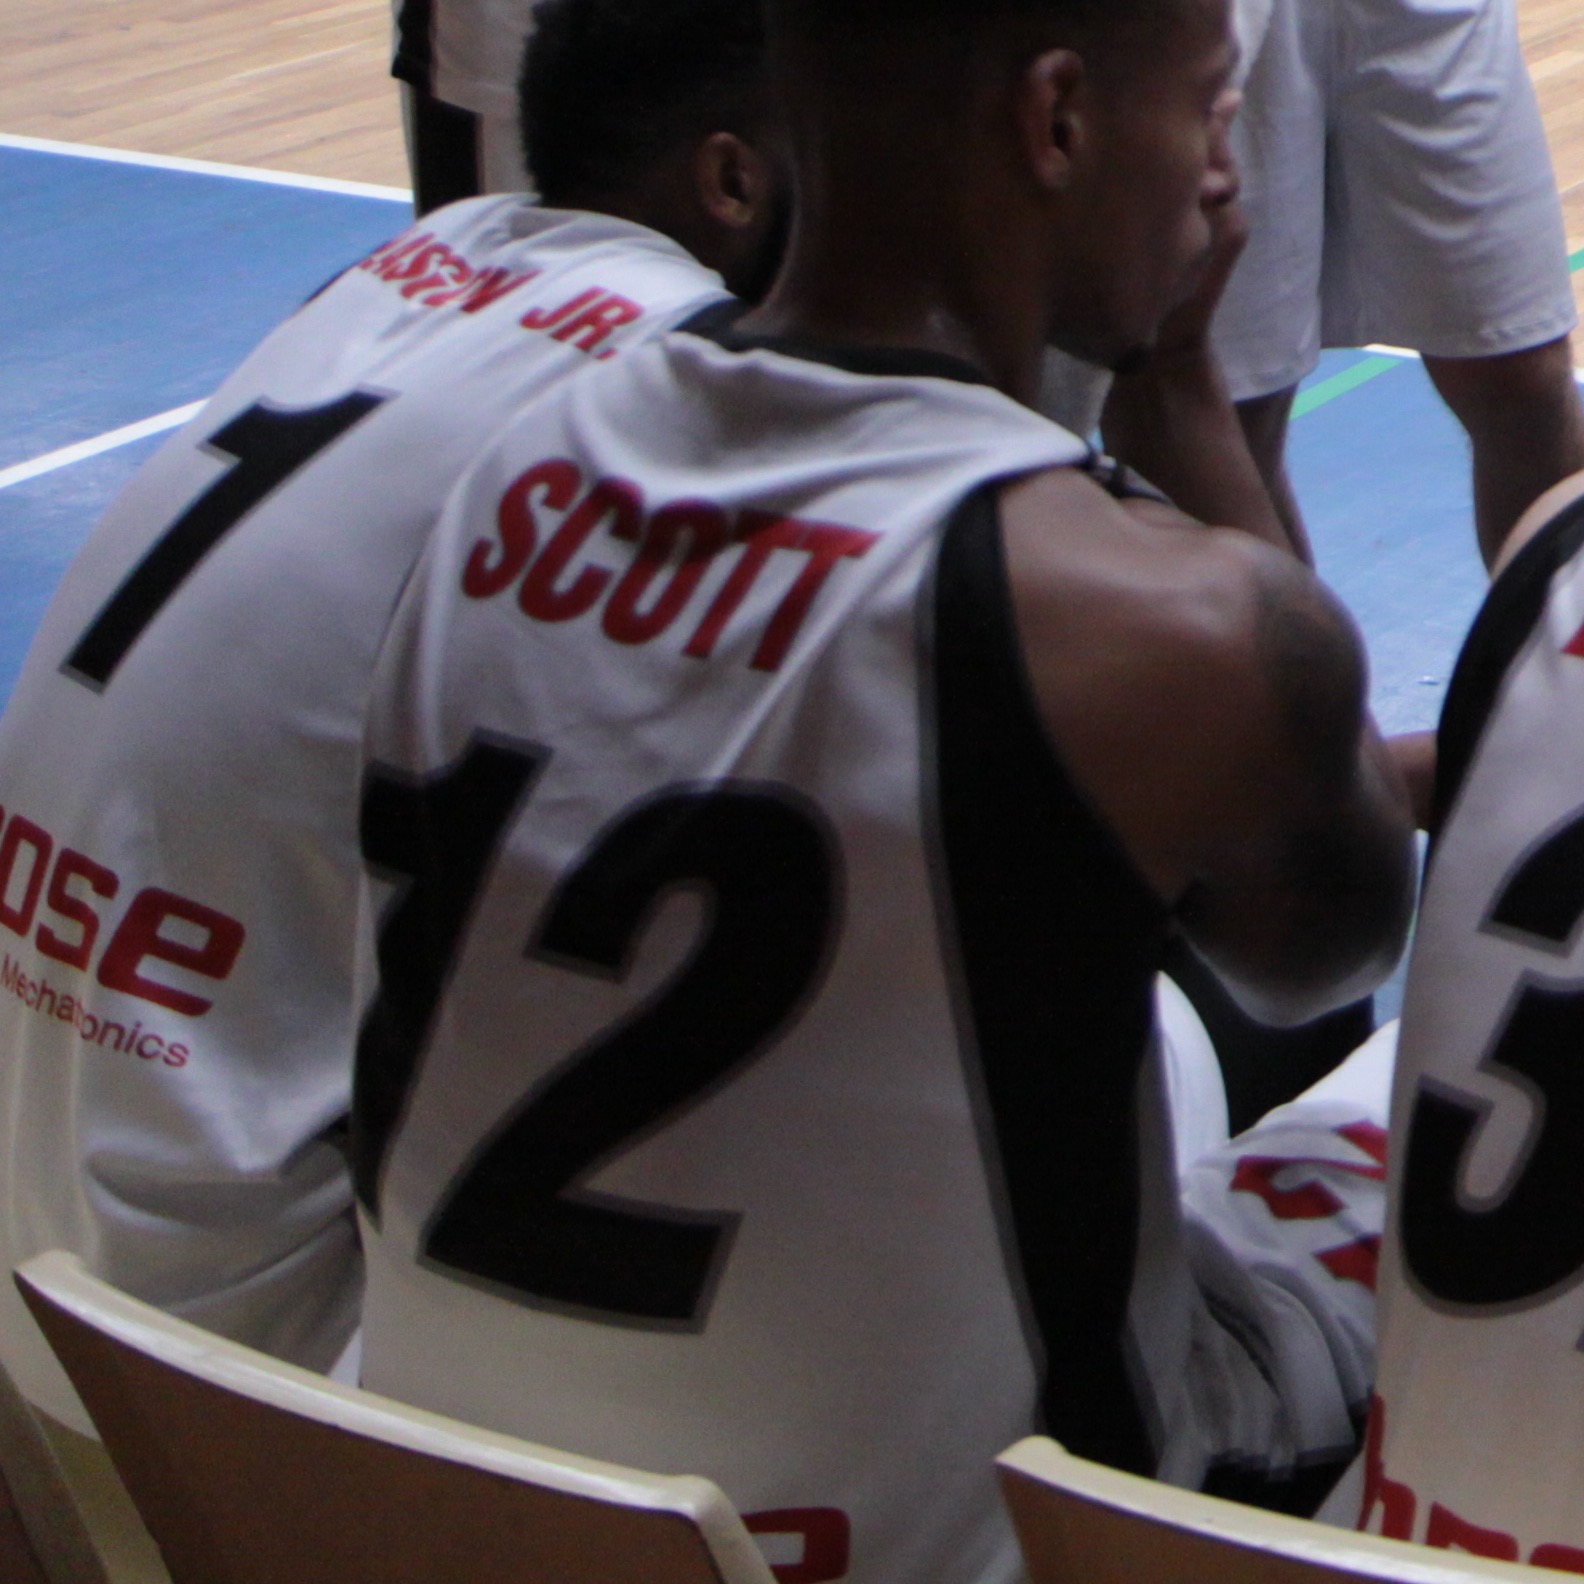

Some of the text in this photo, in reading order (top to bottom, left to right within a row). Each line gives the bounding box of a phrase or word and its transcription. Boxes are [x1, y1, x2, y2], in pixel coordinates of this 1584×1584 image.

[519, 284, 643, 361] JR.
[60, 391, 402, 693] 1
[462, 458, 878, 675] SCOTT
[356, 727, 848, 1336] 12
